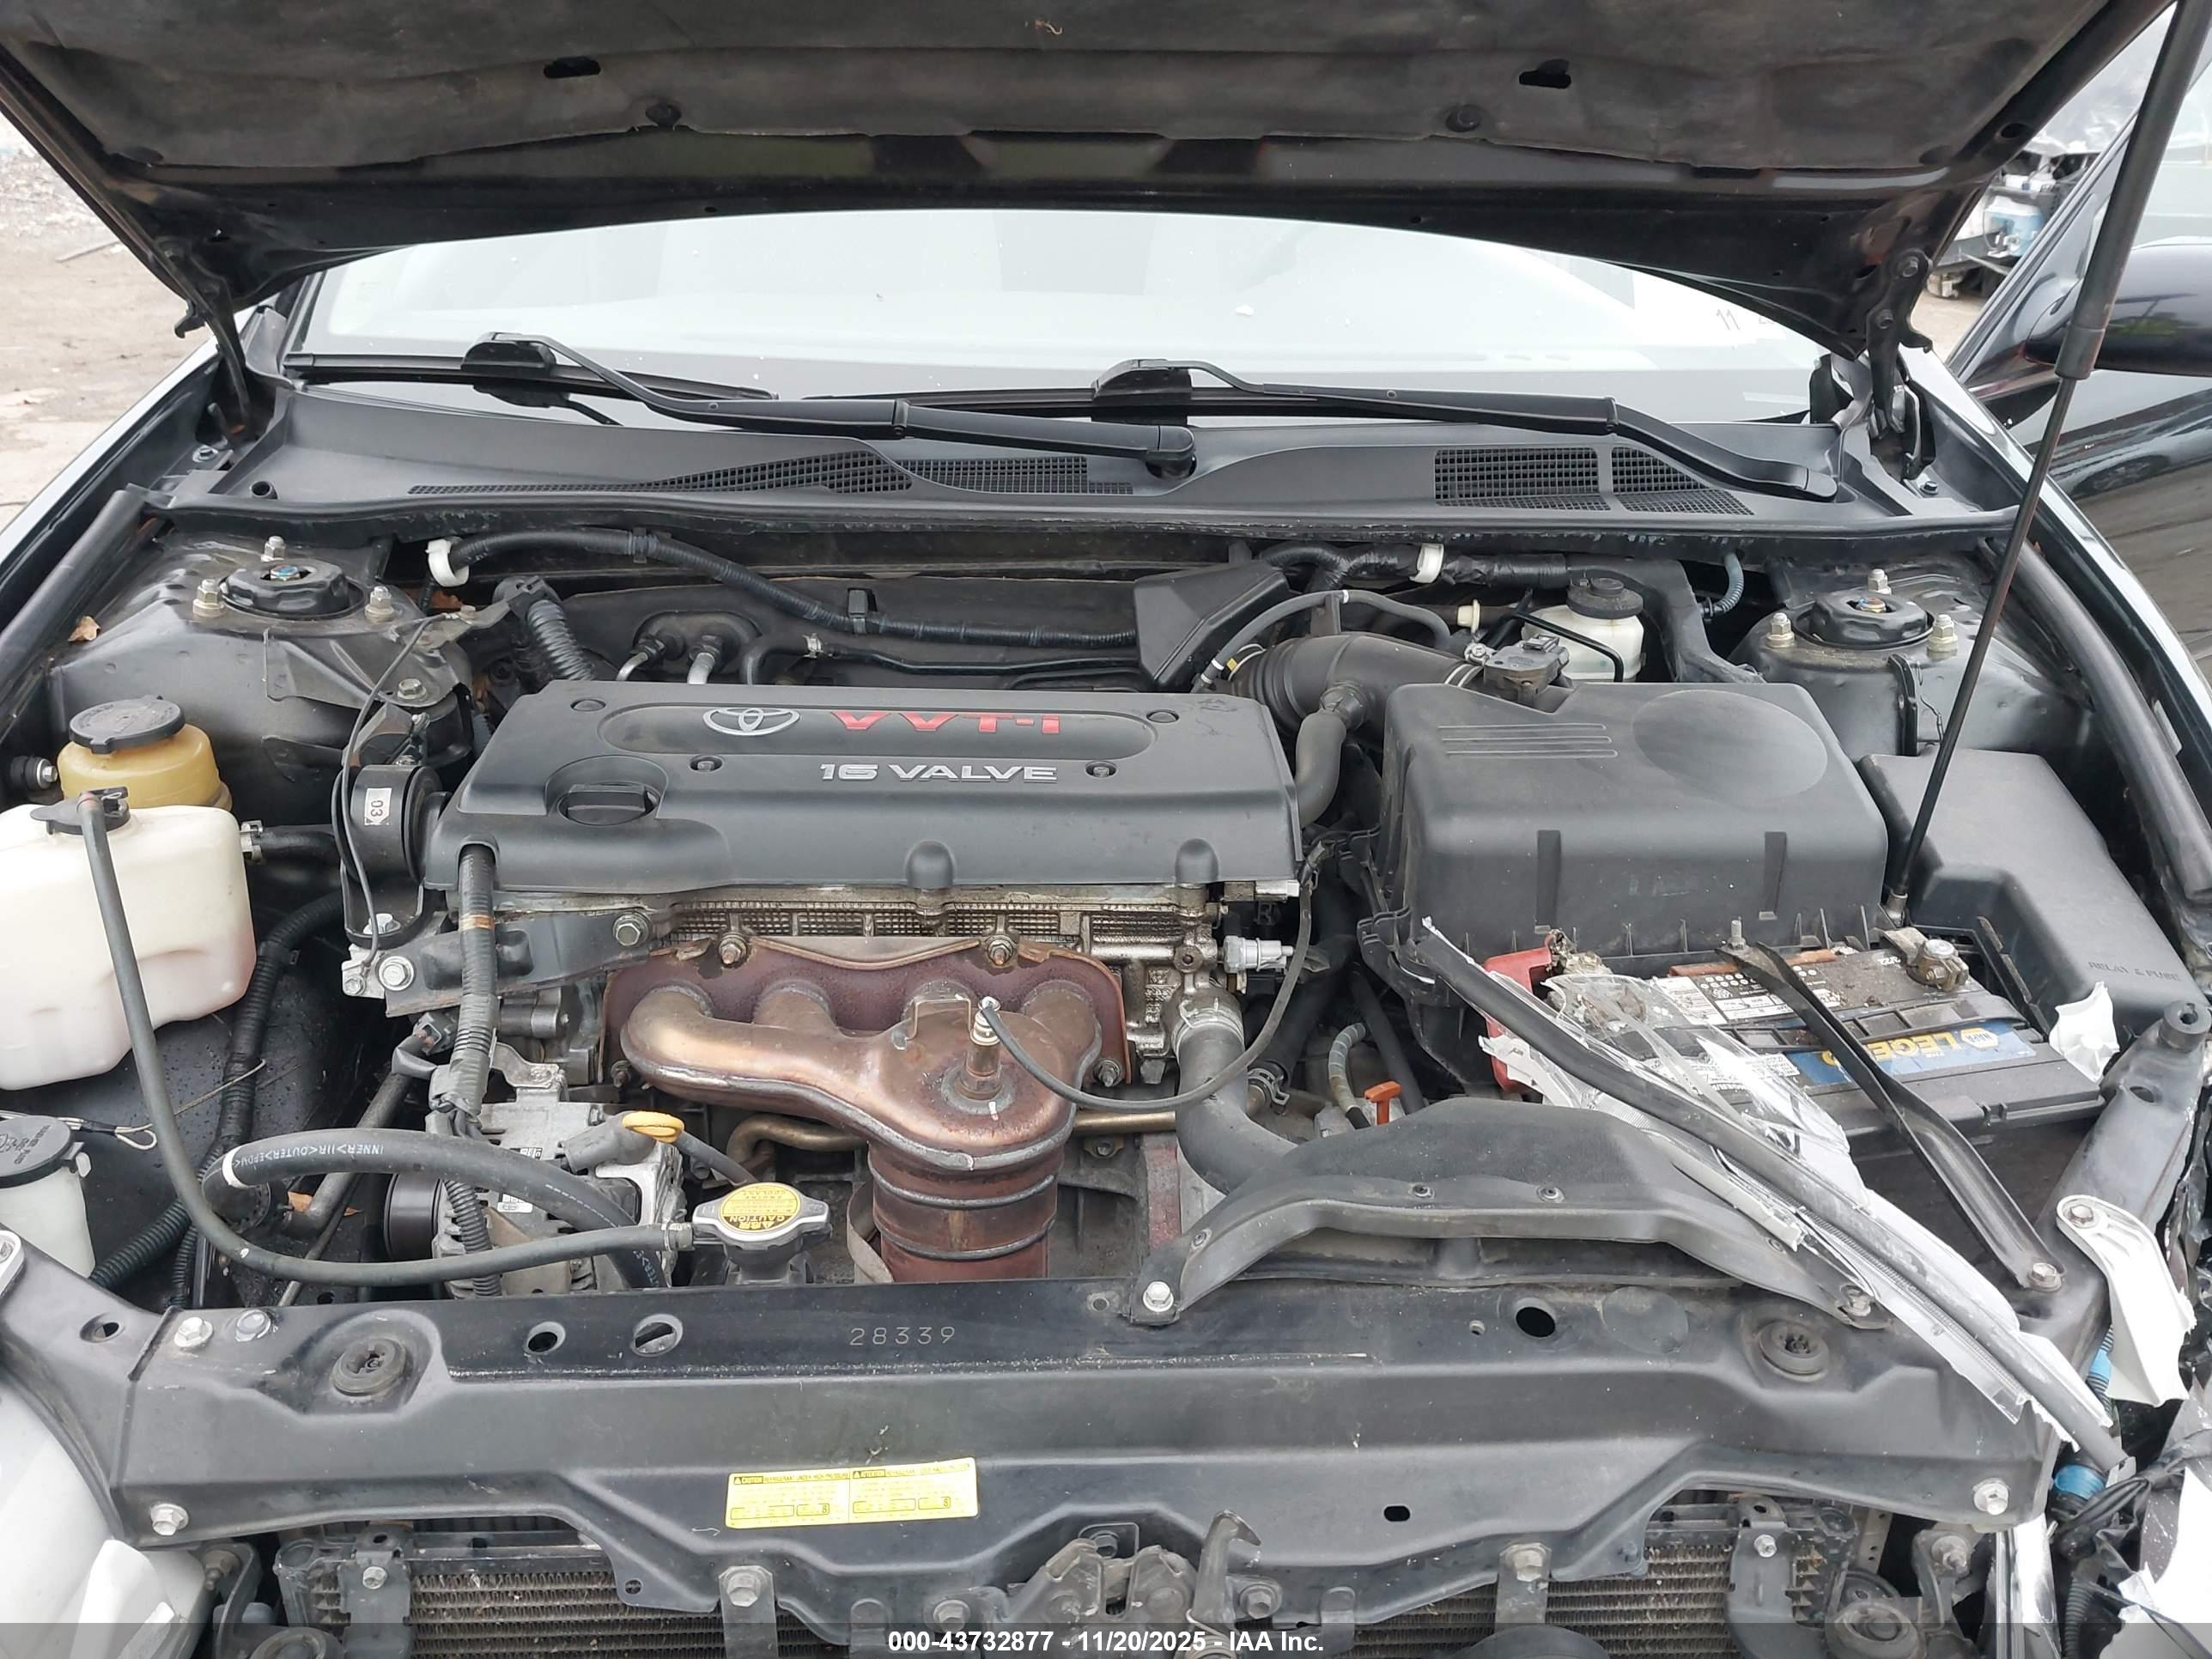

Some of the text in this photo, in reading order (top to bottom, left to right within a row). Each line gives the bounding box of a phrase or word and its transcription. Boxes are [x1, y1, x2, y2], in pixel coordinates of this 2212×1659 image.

[819, 763, 1058, 783] 16 VALVE
[370, 799, 384, 817] 03
[849, 1327, 956, 1346] 28339
